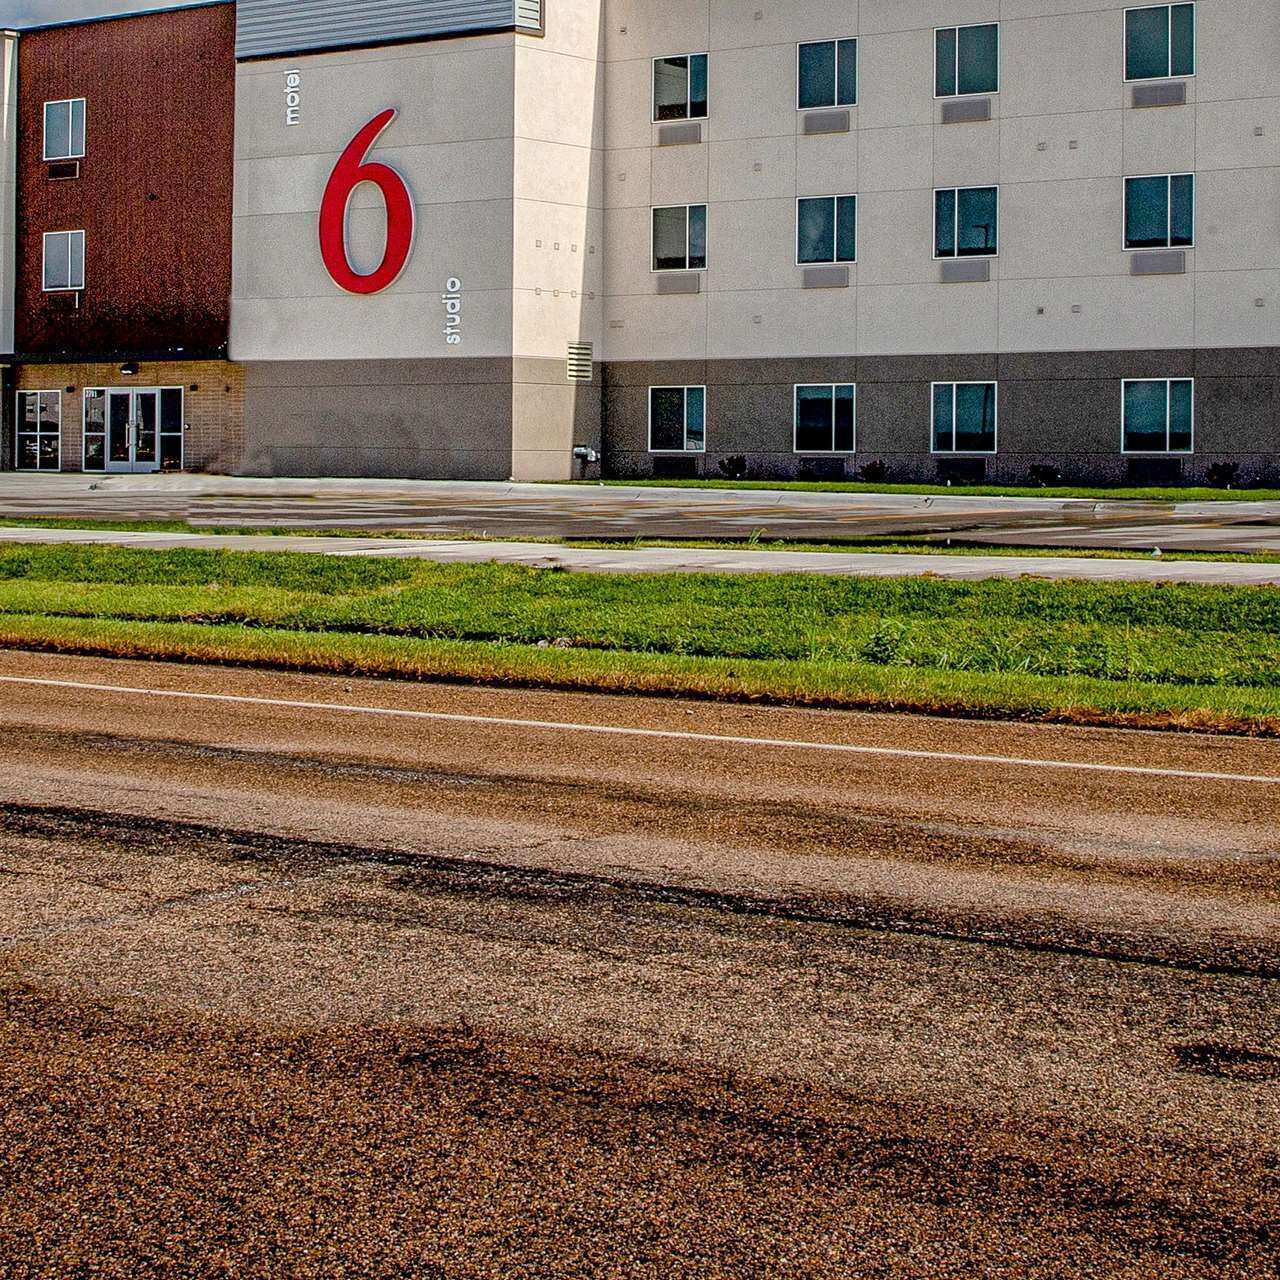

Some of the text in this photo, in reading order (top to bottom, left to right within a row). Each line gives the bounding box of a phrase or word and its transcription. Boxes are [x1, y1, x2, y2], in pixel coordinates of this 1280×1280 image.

[283, 69, 301, 126] motel
[318, 107, 416, 296] 6
[441, 277, 462, 345] studio
